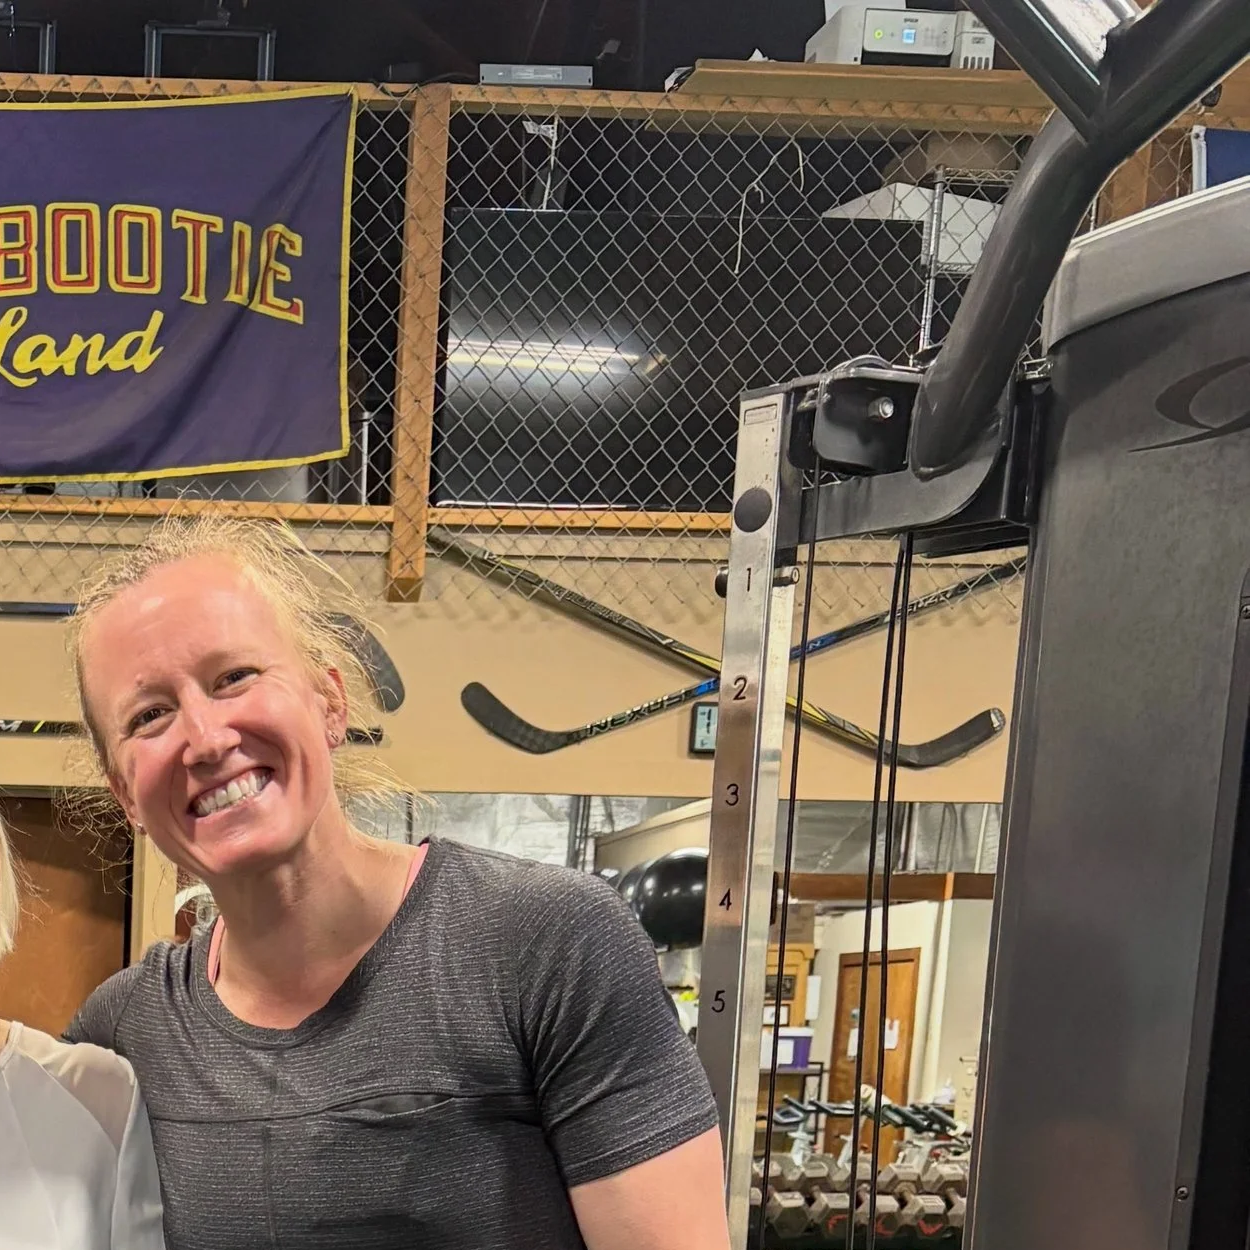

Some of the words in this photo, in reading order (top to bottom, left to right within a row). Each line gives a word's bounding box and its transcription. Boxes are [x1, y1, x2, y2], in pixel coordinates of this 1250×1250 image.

[746, 567, 751, 592] 1
[734, 677, 747, 700] 2
[726, 783, 739, 806] 3
[719, 888, 732, 911] 4
[711, 990, 725, 1013] 5
